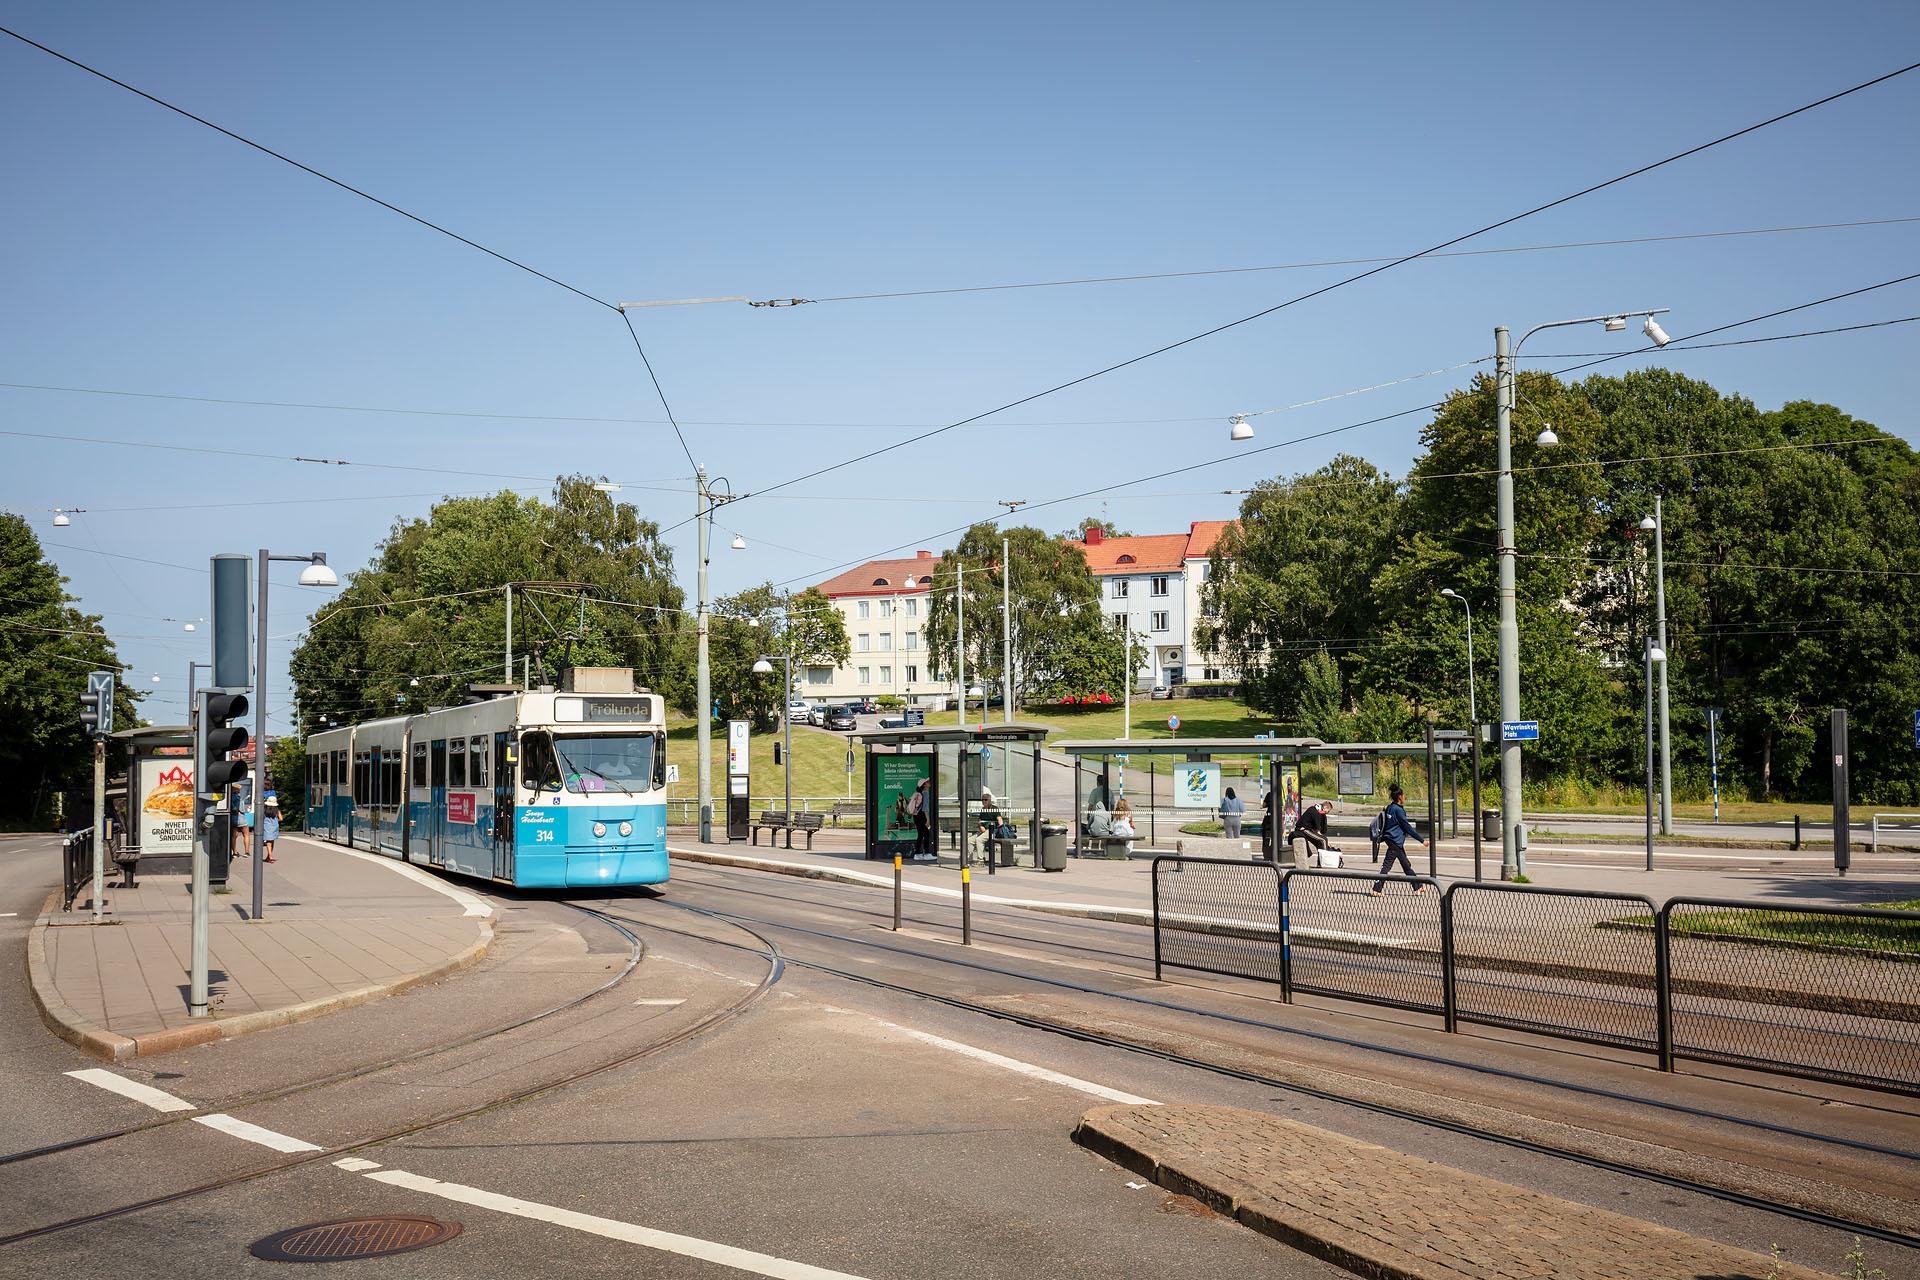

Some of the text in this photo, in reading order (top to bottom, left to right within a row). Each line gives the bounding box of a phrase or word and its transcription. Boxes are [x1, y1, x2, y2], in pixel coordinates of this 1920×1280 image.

[590, 703, 648, 716] Frölunda
[737, 724, 744, 738] C
[159, 766, 193, 785] MAX
[536, 830, 554, 842] 314
